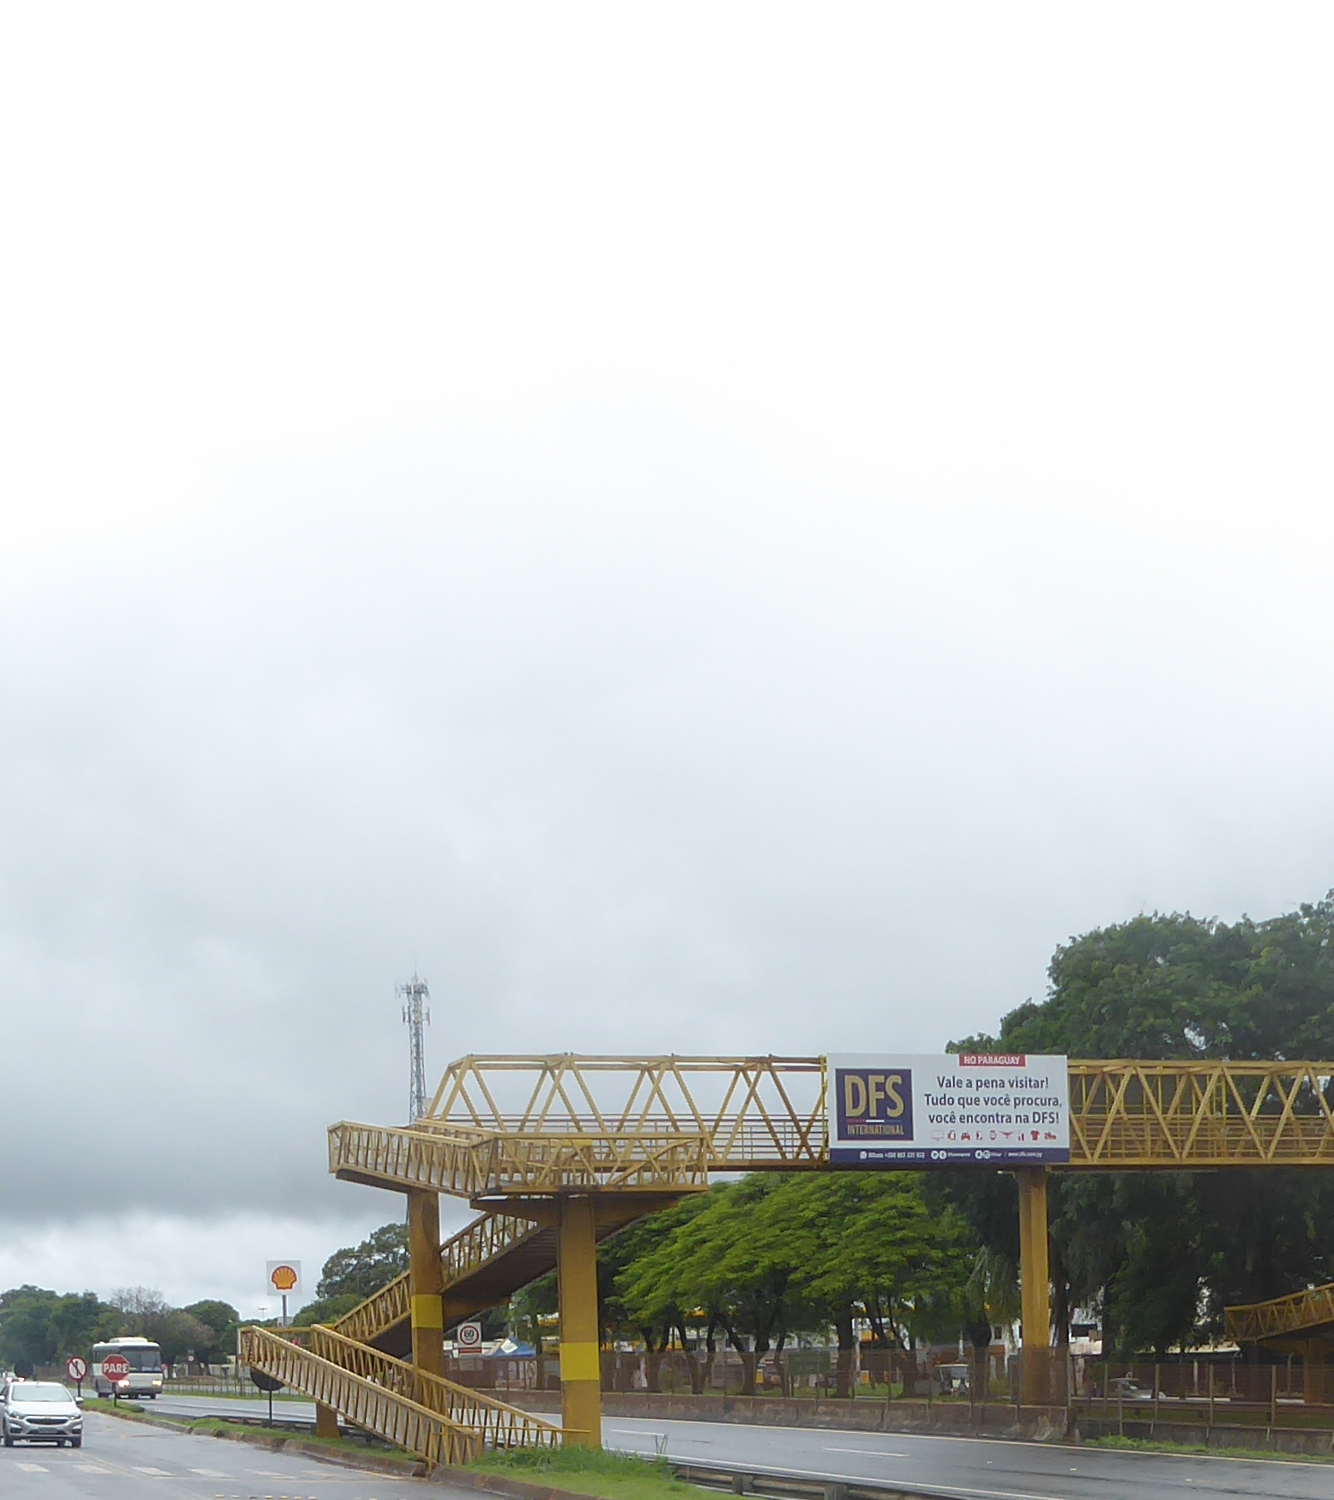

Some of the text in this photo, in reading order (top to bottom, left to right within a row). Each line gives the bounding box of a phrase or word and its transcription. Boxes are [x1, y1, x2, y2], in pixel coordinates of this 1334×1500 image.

[978, 1056, 1021, 1065] PARAGUAY
[937, 1075, 1049, 1091] Vale a pena visitar!
[844, 1074, 905, 1118] DFS
[924, 1093, 1062, 1109] Tudo que você procura,
[928, 1111, 1059, 1124] você encontra na DFS!
[847, 1124, 905, 1135] INTERNATIONAL
[103, 1363, 128, 1374] PARE
